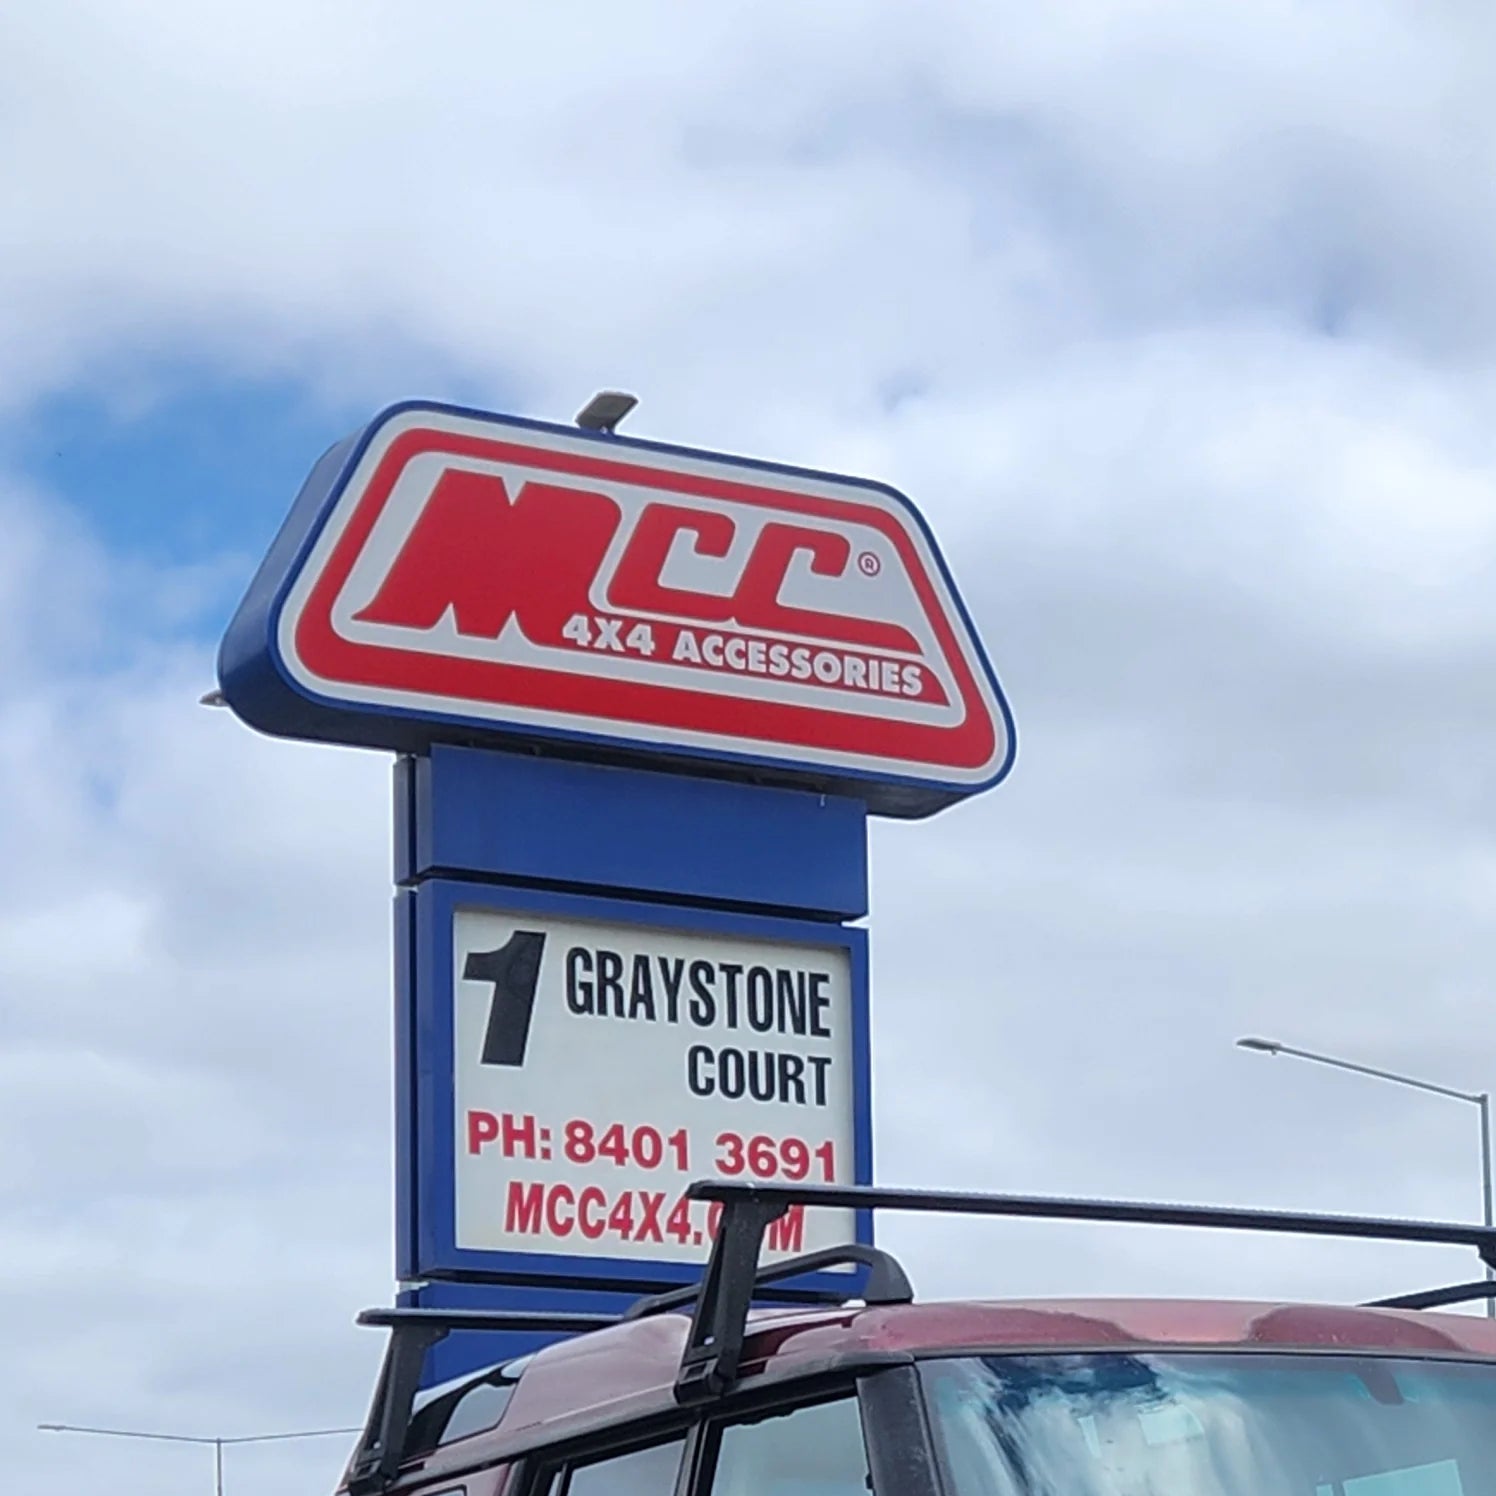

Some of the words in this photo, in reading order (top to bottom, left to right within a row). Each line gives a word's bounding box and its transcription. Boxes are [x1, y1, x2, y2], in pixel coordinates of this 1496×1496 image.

[352, 468, 924, 656] MCC
[562, 613, 656, 656] 4X4
[672, 629, 923, 696] ACCESSORIES
[462, 929, 547, 1067] 1
[566, 946, 831, 1038] GRAYSTONE
[688, 1044, 832, 1106] COURT
[467, 1110, 552, 1161] PH:
[563, 1120, 690, 1171] 8401
[715, 1132, 835, 1182] 3691
[505, 1180, 806, 1252] MCC4X4.M
